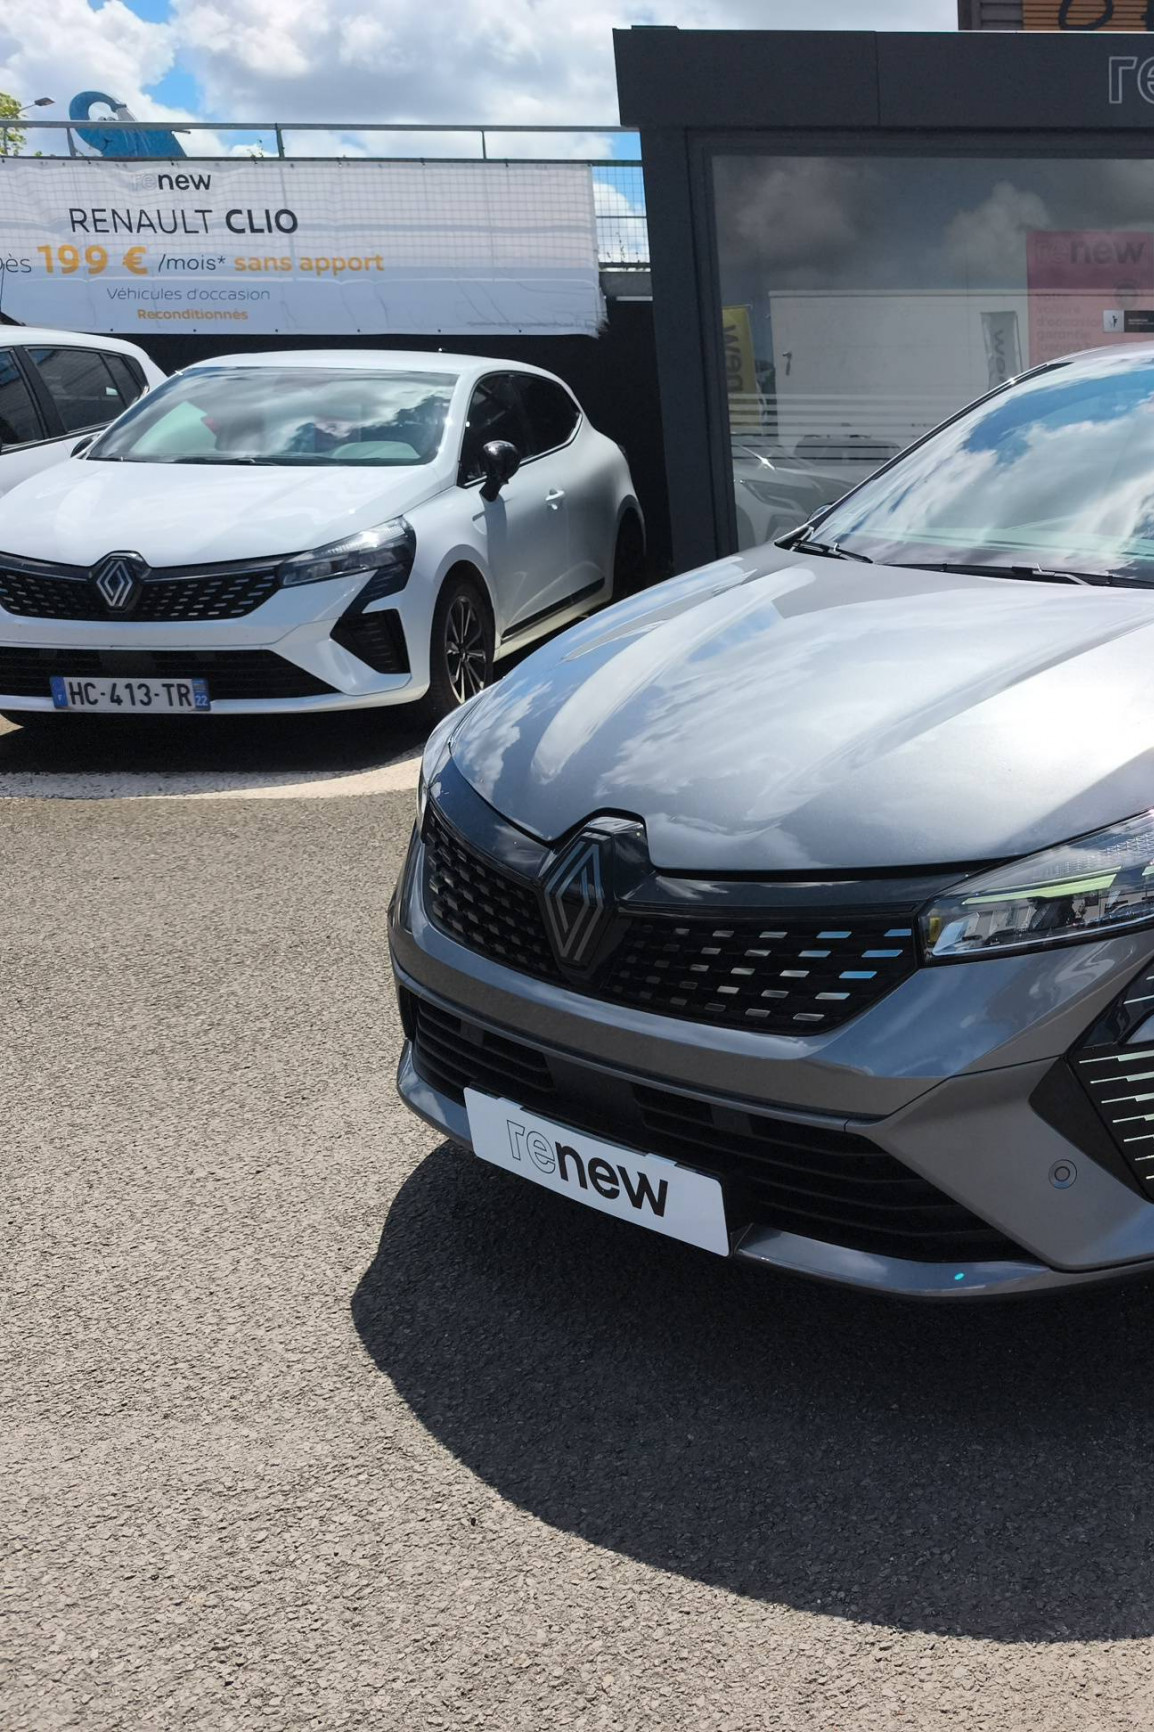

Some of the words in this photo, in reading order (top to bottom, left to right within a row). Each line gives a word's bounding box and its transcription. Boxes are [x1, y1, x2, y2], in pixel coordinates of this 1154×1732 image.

[69, 208, 212, 234] RENAULT
[225, 208, 299, 234] CLIO
[0, 253, 32, 273] ès
[37, 244, 109, 275] 199
[122, 246, 149, 275] €
[234, 256, 293, 272] sans
[299, 254, 385, 277] apport
[106, 287, 182, 301] Véhicules
[187, 287, 270, 301] d'occasion
[137, 308, 248, 320] Reconditionnés
[68, 681, 192, 707] HC-413-TR
[195, 695, 208, 706] 22
[506, 1119, 669, 1218] renew
